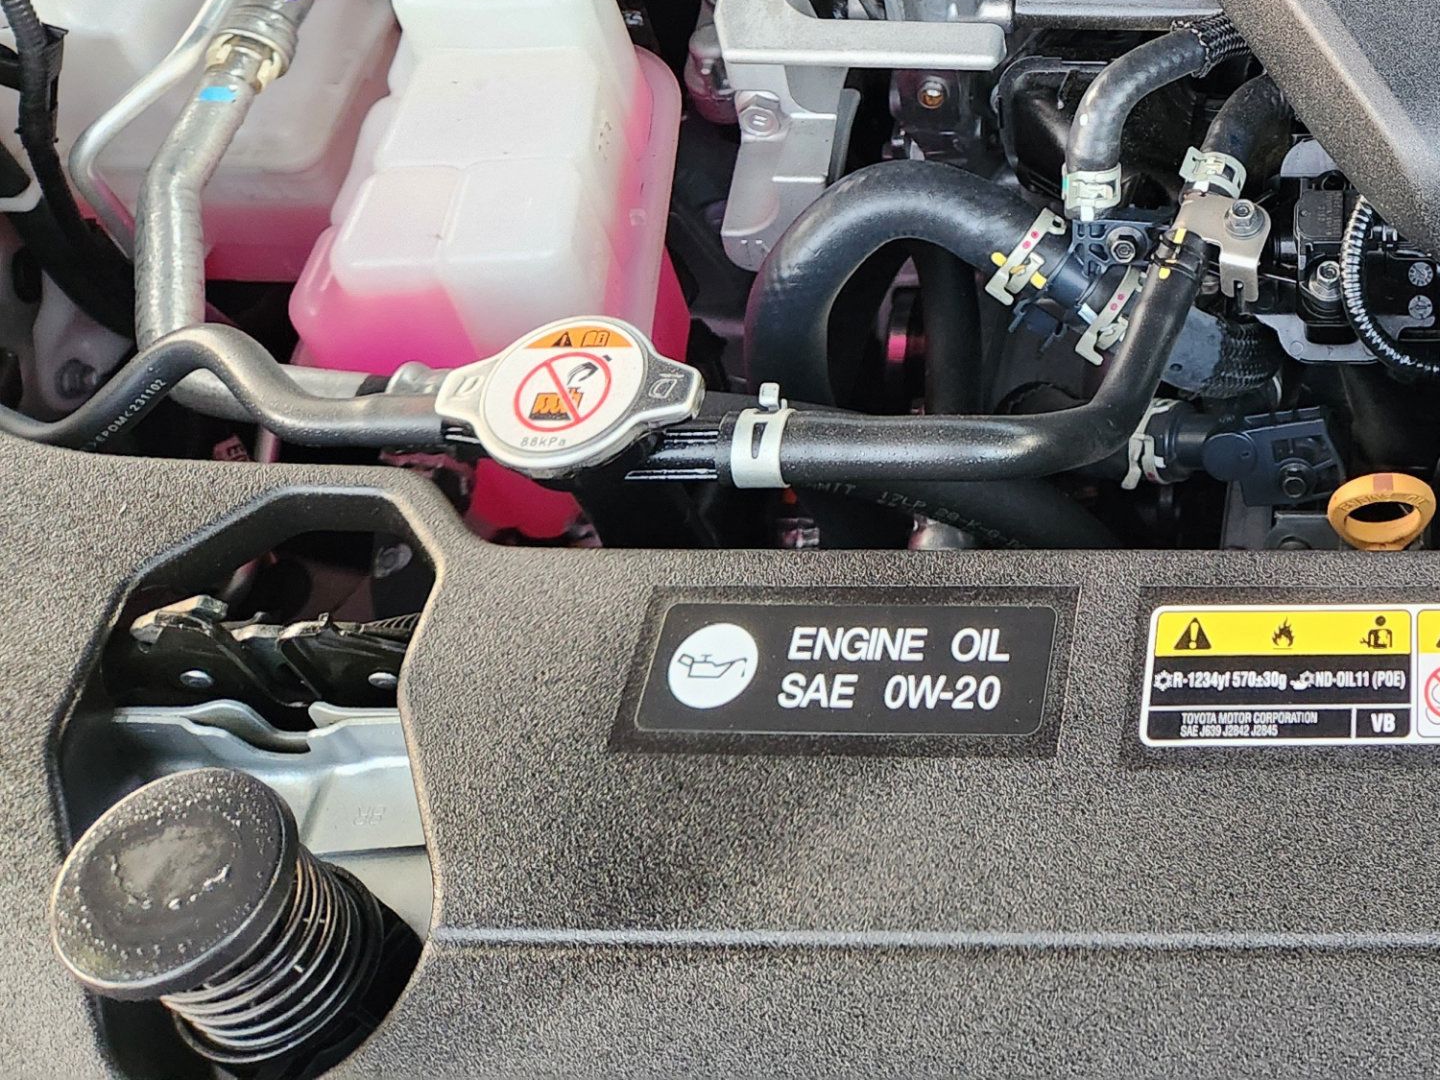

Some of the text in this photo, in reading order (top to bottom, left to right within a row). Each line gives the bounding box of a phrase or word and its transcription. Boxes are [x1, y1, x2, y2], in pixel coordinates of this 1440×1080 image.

[787, 625, 1011, 663] ENGINE OIL
[777, 671, 1002, 711] SAE 0W-20
[1172, 670, 1407, 692] R-1234yf 570±30g ND-OIL11 (POE)
[1180, 711, 1318, 724] TOYOTA MOTOR CORPORATION
[1370, 712, 1397, 734] VB
[1179, 724, 1279, 738] SAE J639 J2842 J2845
